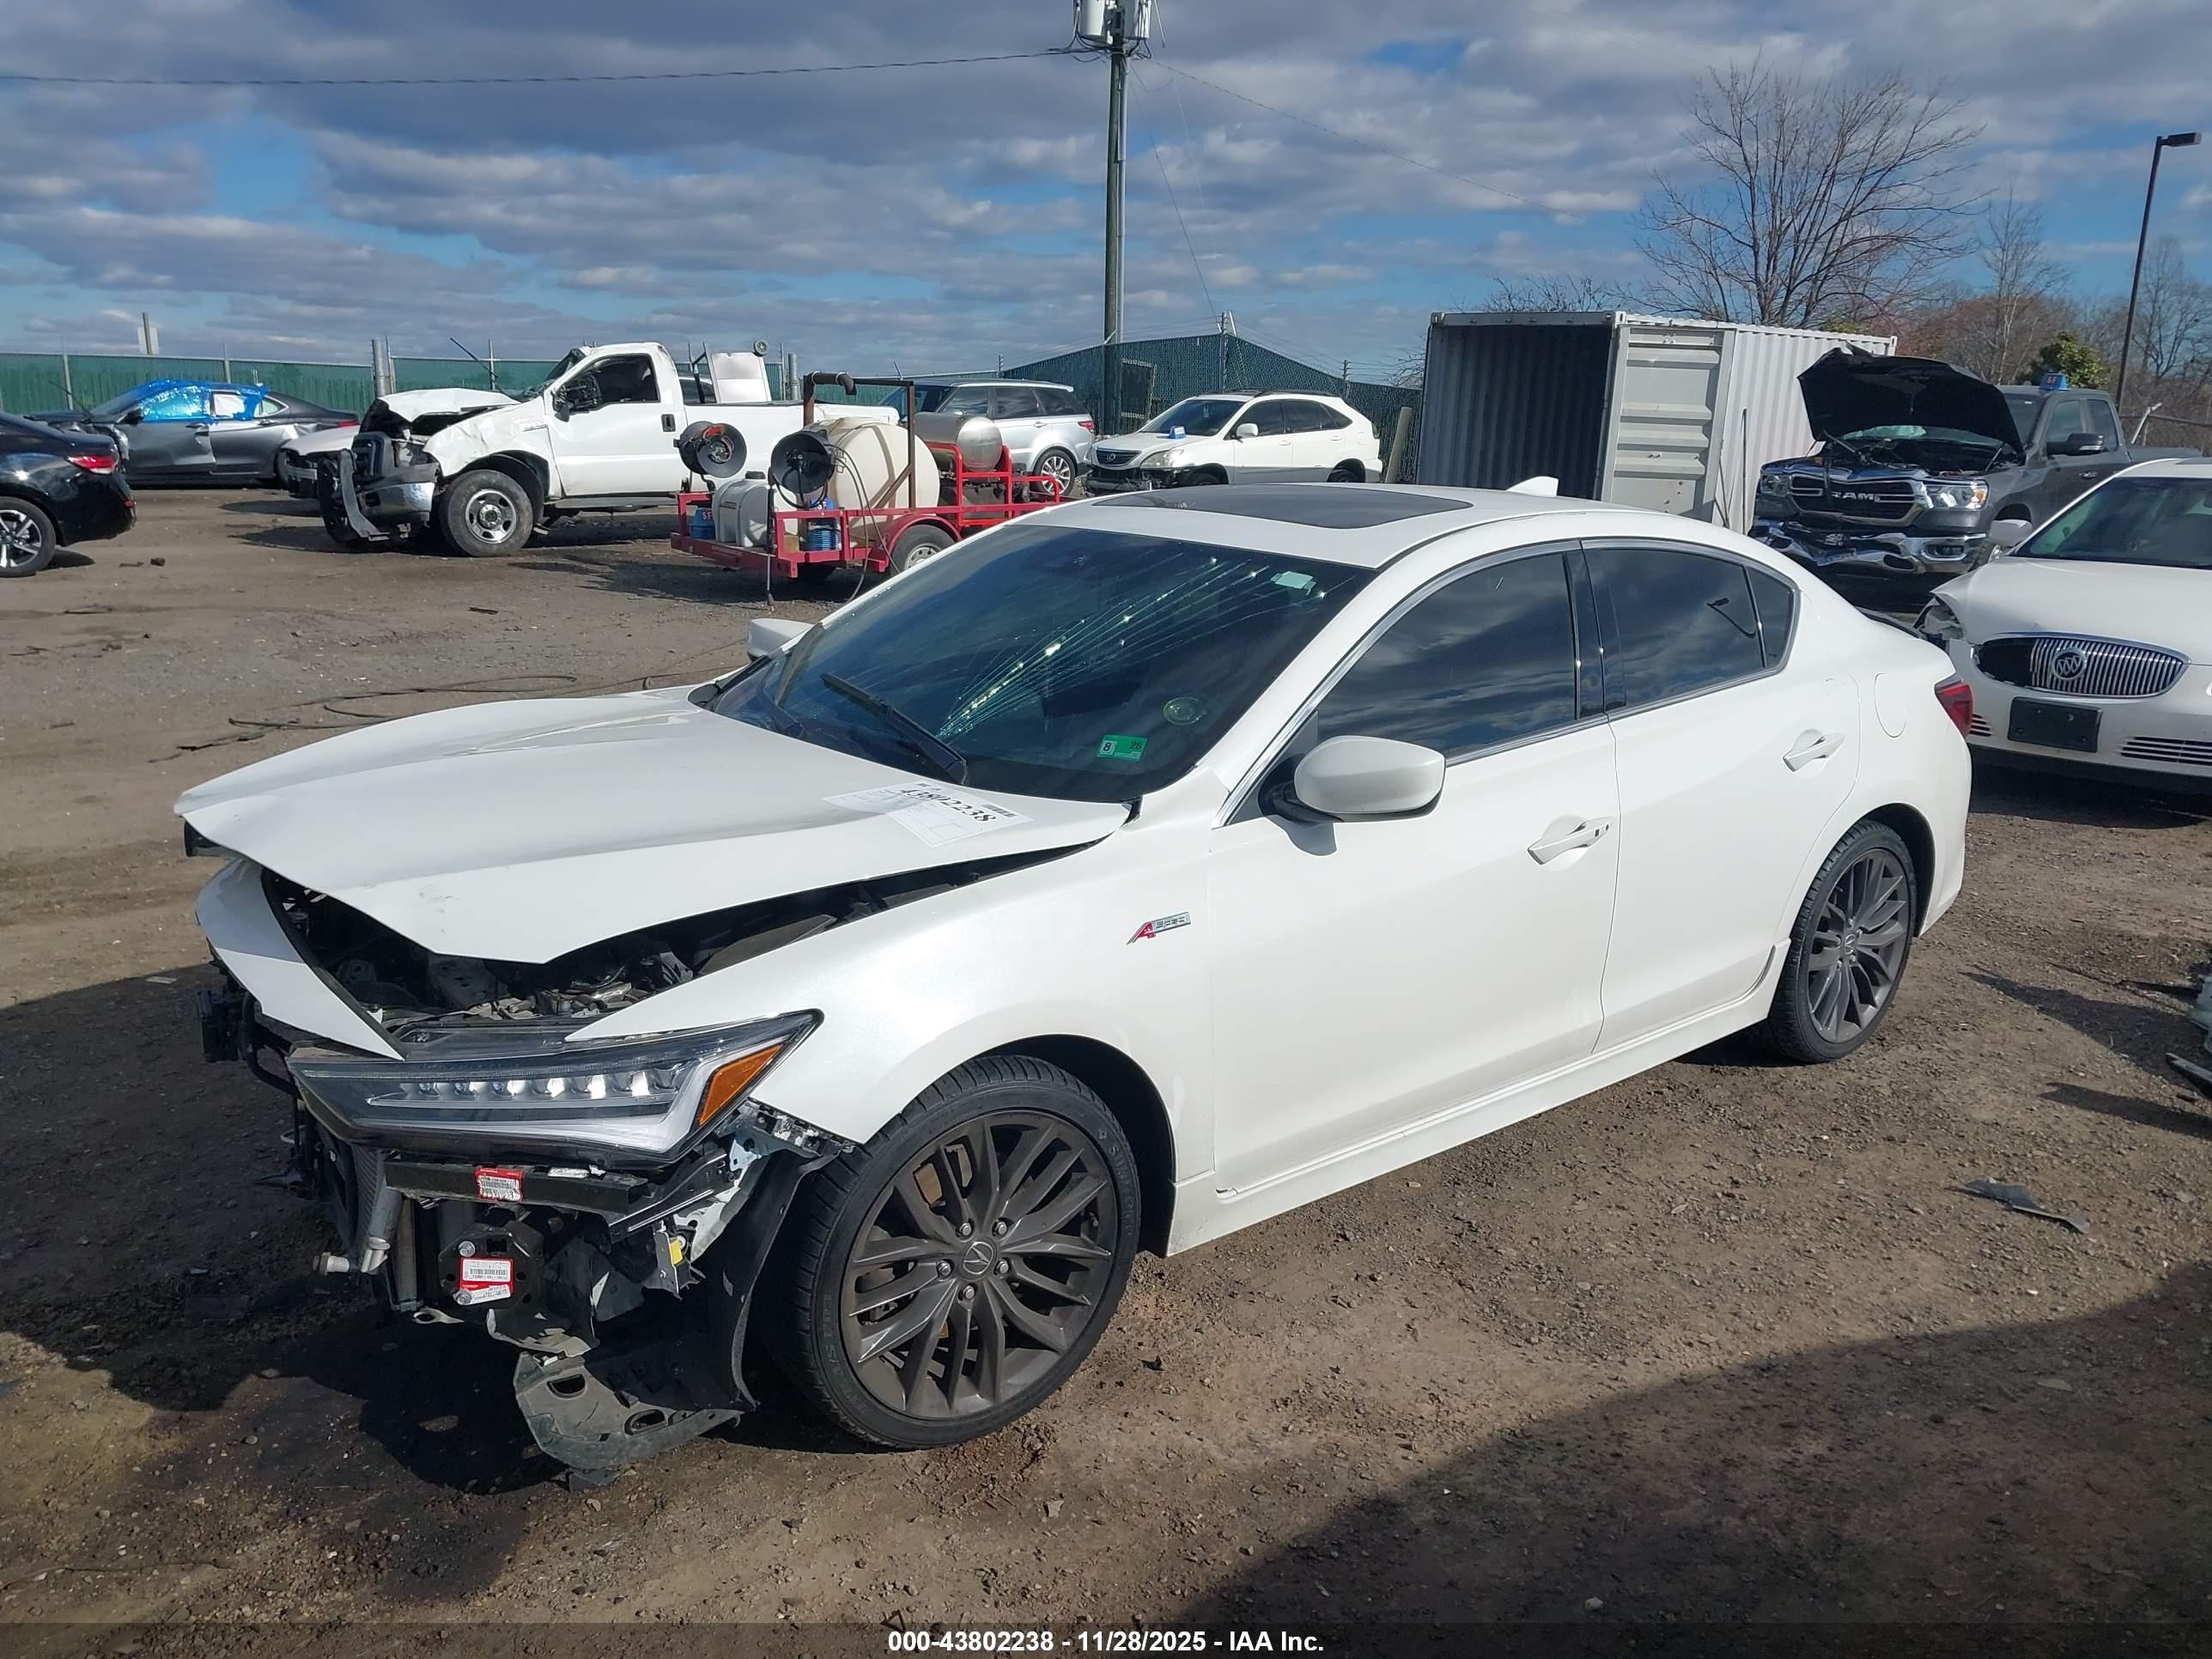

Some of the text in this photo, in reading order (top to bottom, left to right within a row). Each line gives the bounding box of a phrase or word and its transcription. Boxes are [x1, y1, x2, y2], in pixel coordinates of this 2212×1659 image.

[1831, 491, 1875, 501] RAM
[1103, 741, 1112, 751] 8
[899, 788, 997, 822] 43802238
